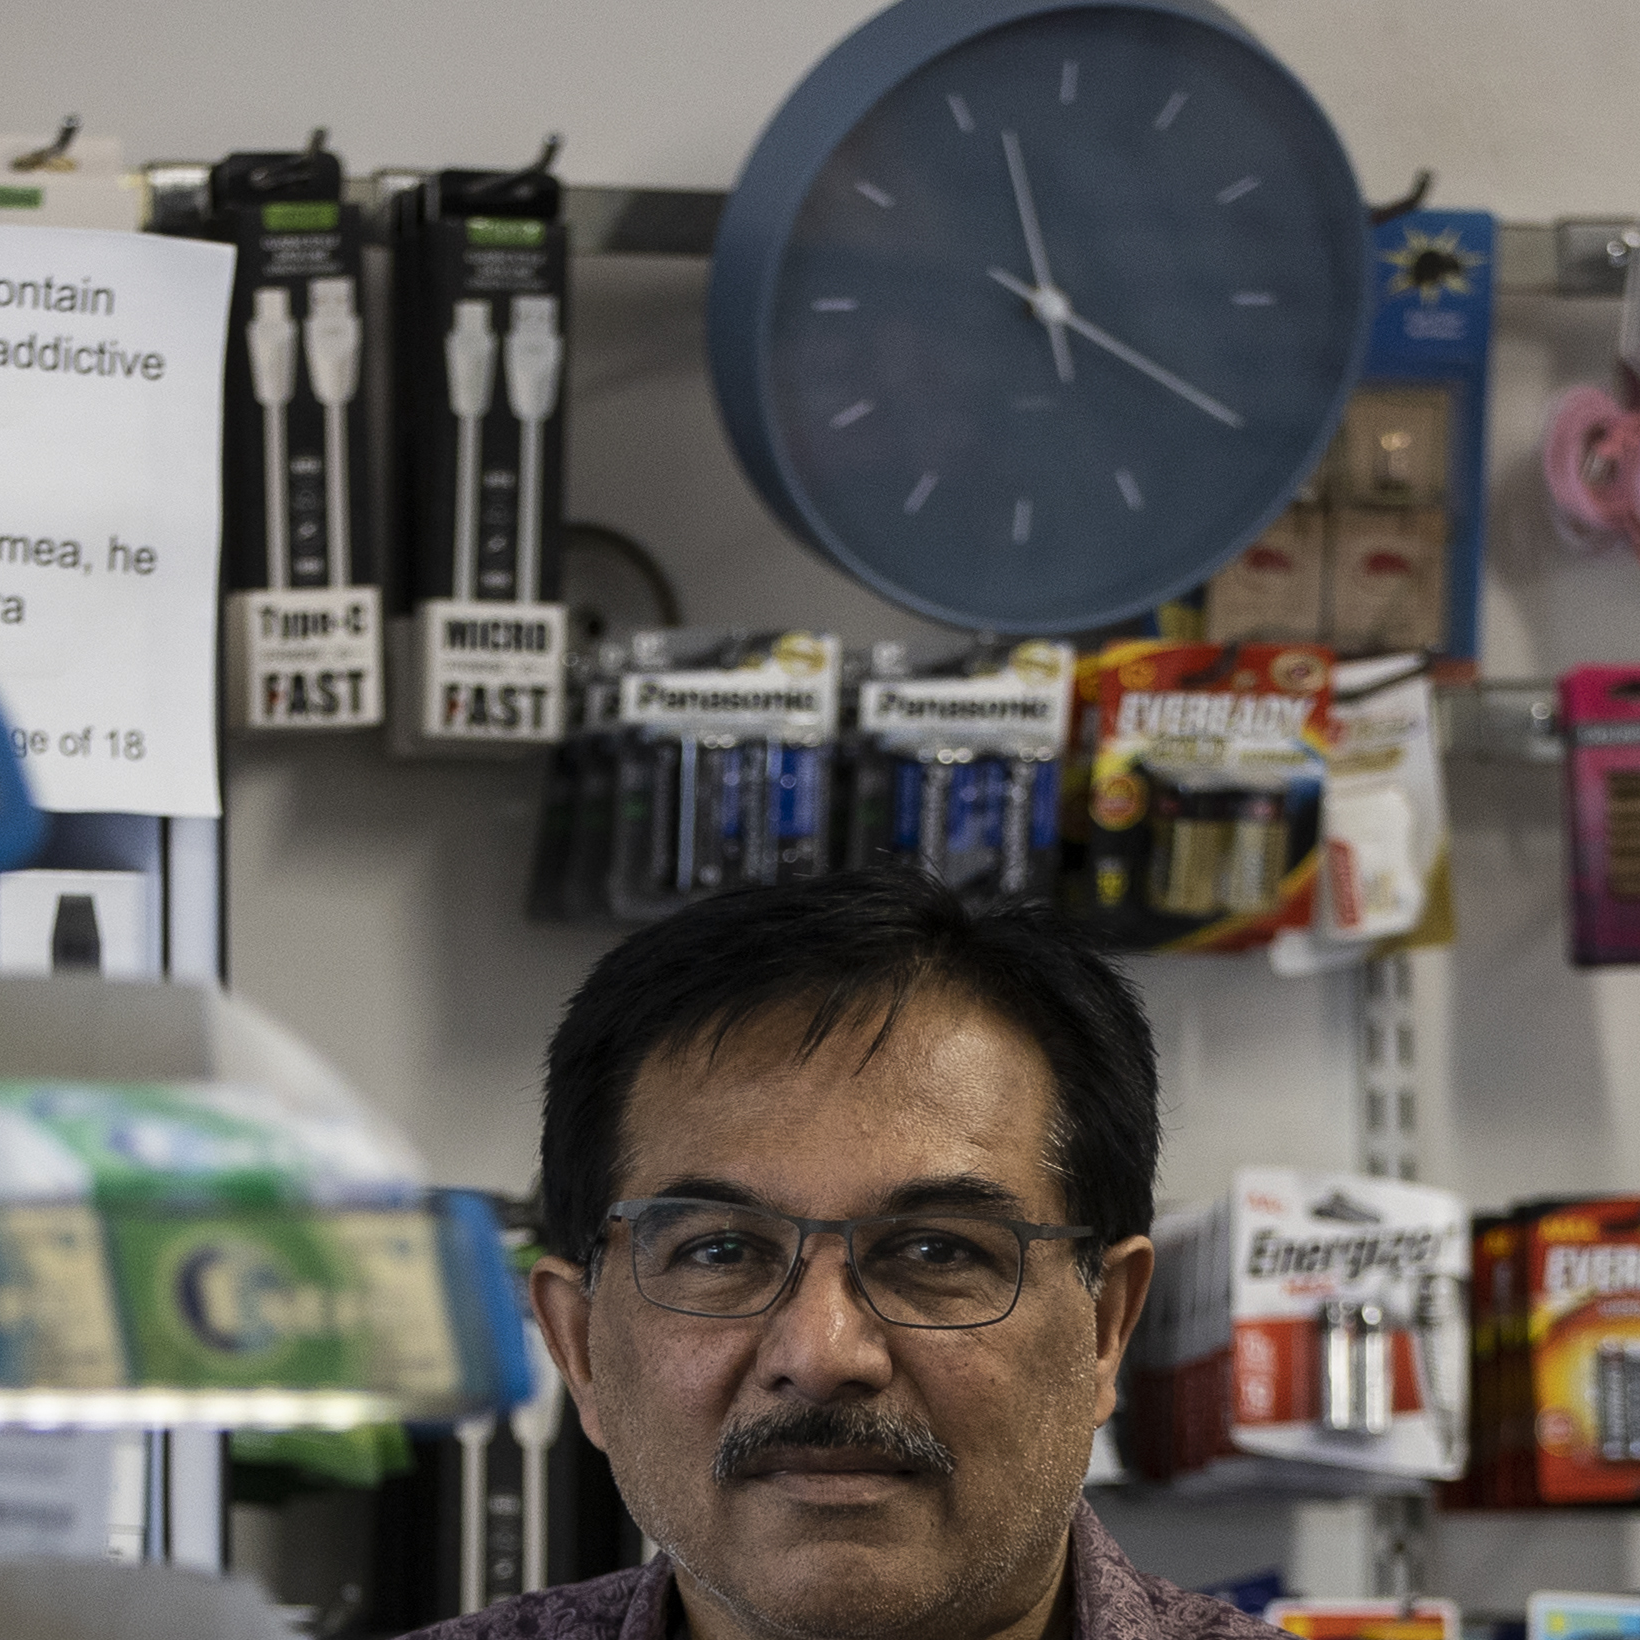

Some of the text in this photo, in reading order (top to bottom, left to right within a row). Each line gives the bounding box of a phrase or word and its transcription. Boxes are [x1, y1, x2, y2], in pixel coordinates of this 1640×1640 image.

[106, 534, 158, 577] he
[266, 670, 363, 716] FAST
[444, 682, 546, 729] FAST
[636, 681, 818, 711] Panasonic
[1116, 691, 1317, 739] EVEREADY
[58, 725, 95, 758] of
[105, 728, 148, 762] 18
[1248, 1228, 1447, 1283] Energizer
